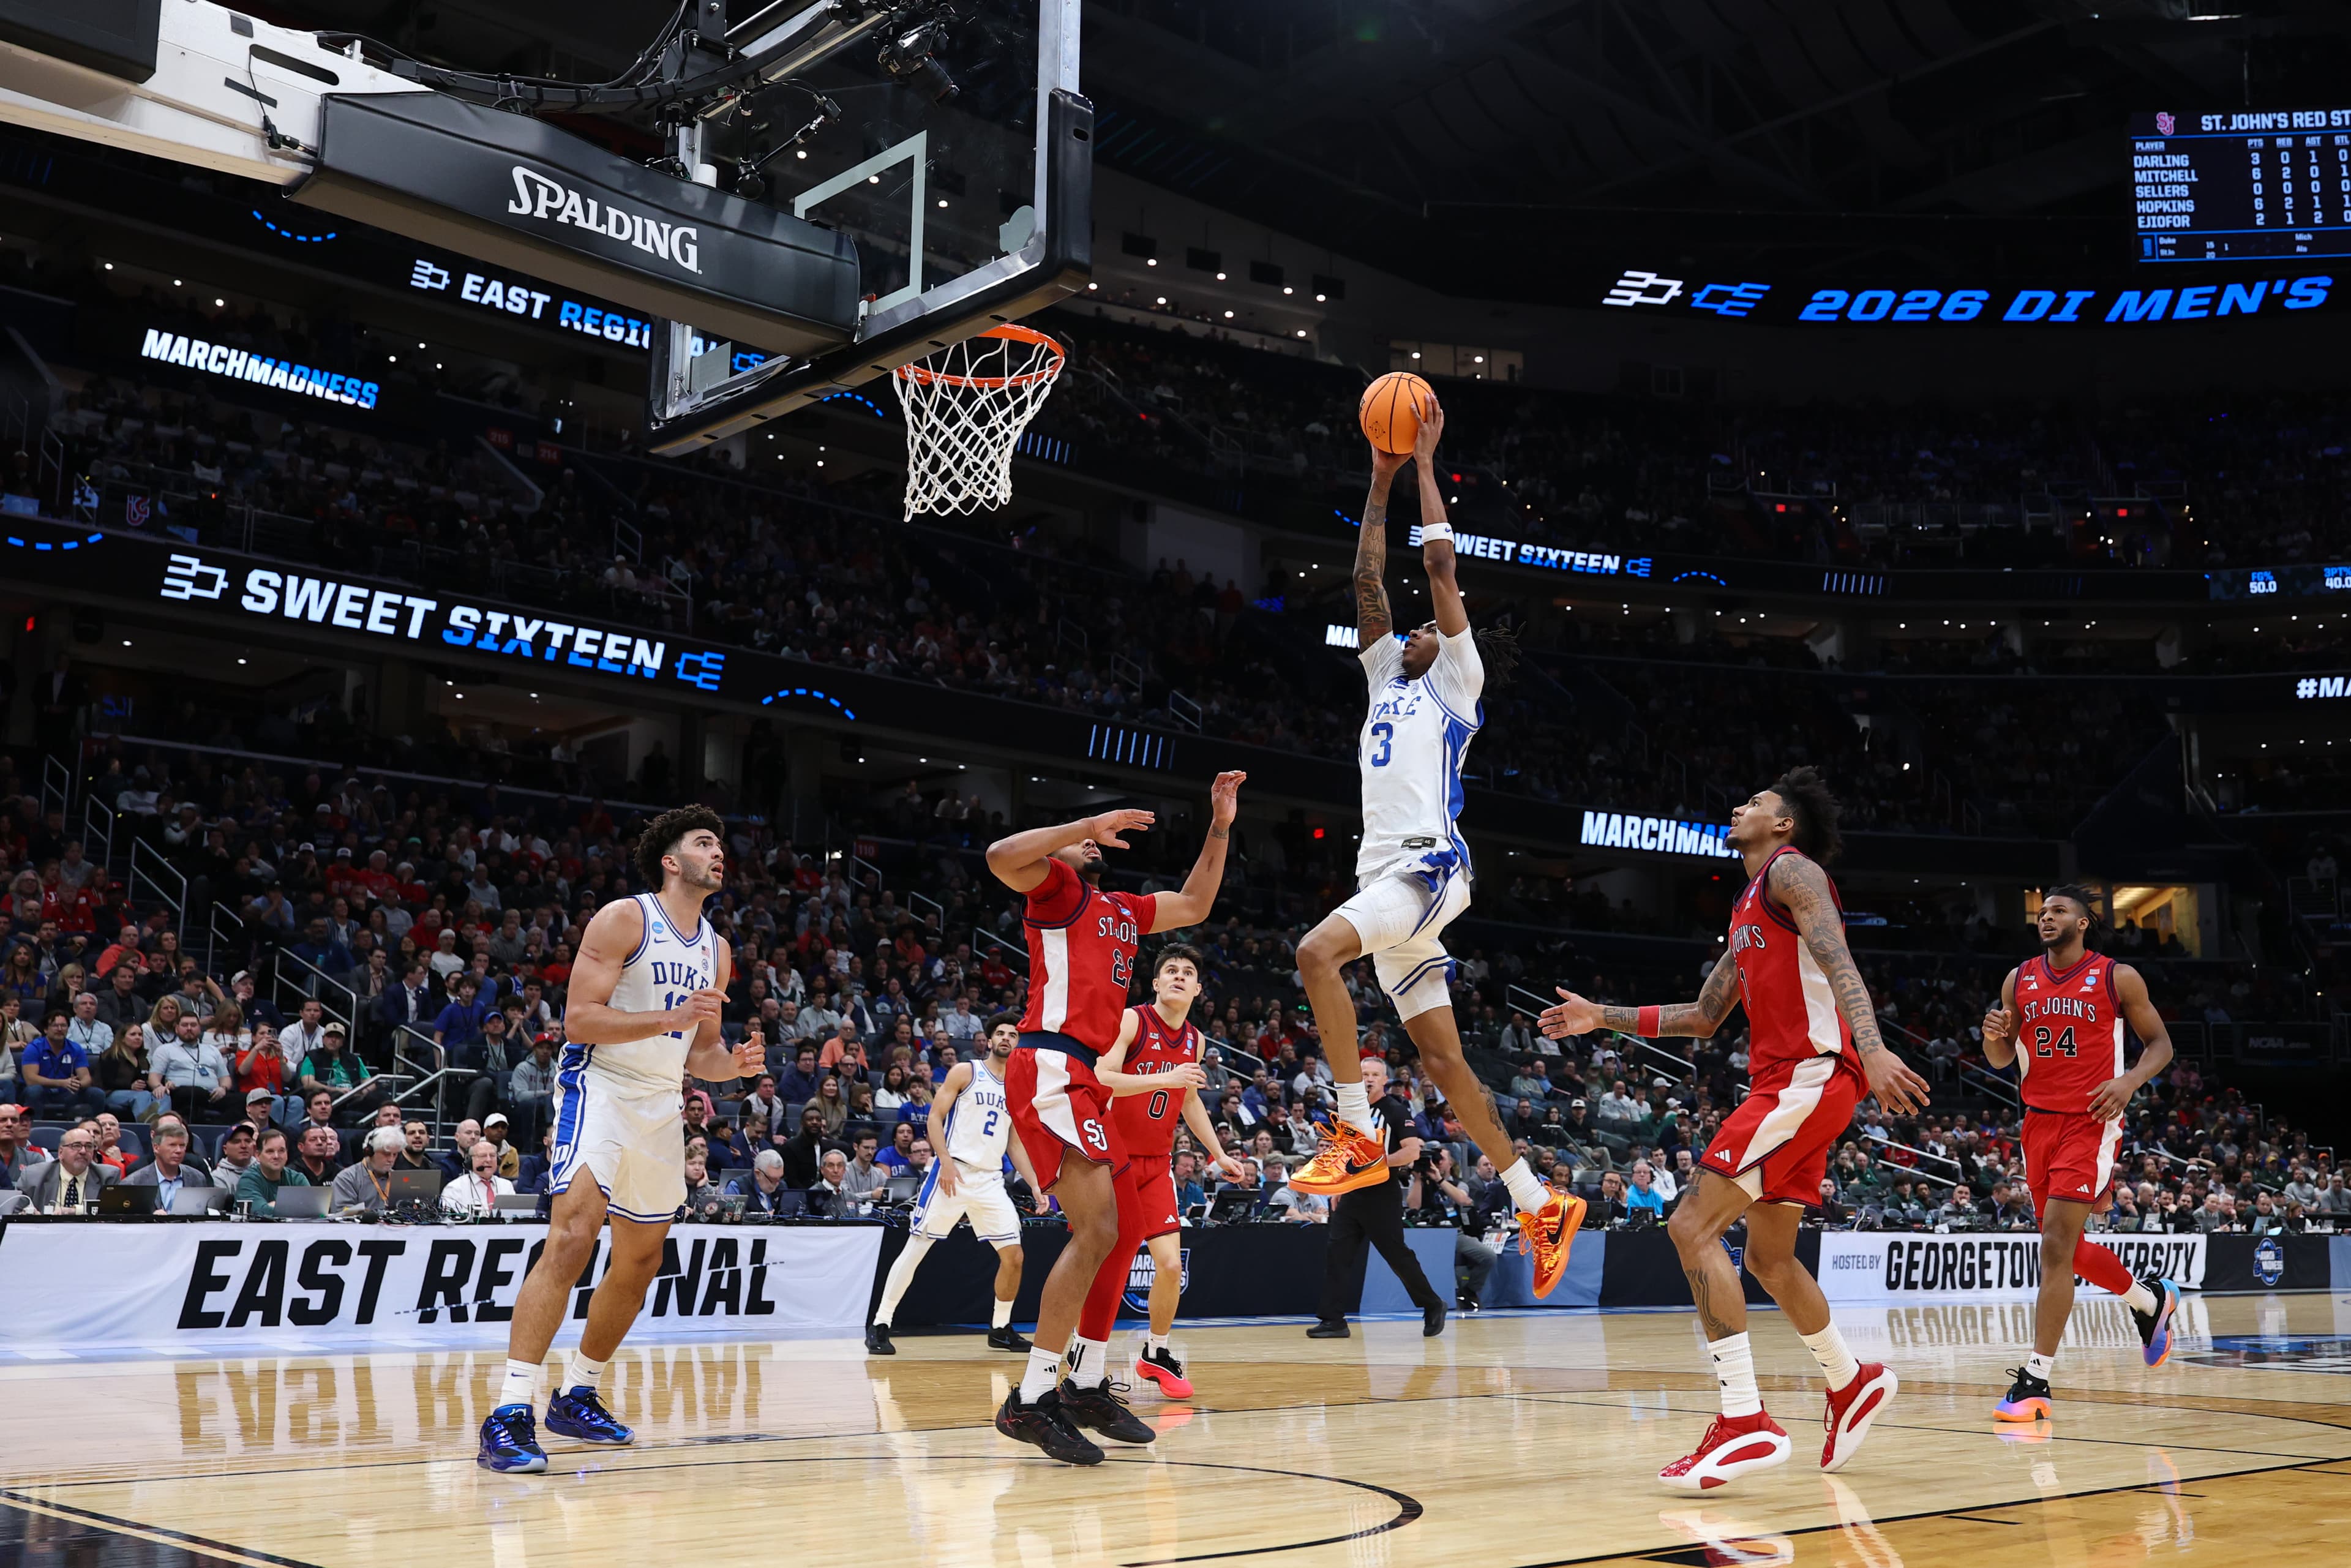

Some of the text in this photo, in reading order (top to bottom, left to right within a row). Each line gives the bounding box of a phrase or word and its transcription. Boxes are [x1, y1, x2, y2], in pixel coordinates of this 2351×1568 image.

[2201, 114, 2226, 131] ST.
[2229, 112, 2289, 130] JOHN'S
[2292, 111, 2327, 129] RED
[2135, 141, 2165, 151] PLAYER
[2248, 138, 2263, 148] PTS
[2305, 136, 2321, 146] AST
[2134, 155, 2189, 168] DARLING
[2251, 152, 2260, 165] 3
[2281, 151, 2290, 164] 0
[2309, 151, 2317, 163] 1
[2339, 149, 2348, 162] 0
[2134, 170, 2199, 183] MITCHELL
[2252, 167, 2261, 180] 6
[2282, 167, 2291, 179] 2
[2310, 165, 2319, 178] 0
[2341, 164, 2349, 177] 1
[2135, 185, 2189, 198] SELLERS
[2253, 182, 2262, 195] 0
[2283, 181, 2292, 194] 0
[2311, 181, 2320, 193] 0
[2341, 179, 2350, 192] 0
[2137, 200, 2195, 213] HOPKINS
[2254, 198, 2263, 210] 6
[2284, 197, 2293, 209] 2
[2313, 195, 2321, 208] 1
[2343, 195, 2351, 207] 1
[508, 165, 698, 274] SPALDING
[2137, 215, 2191, 228] EJIOFOR
[2255, 213, 2265, 225] 2
[2286, 212, 2294, 225] 1
[2314, 211, 2323, 223] 2
[2344, 209, 2351, 222] 0
[461, 273, 550, 319] EAST
[1798, 276, 2333, 322] 2026 DI MEN'S
[141, 329, 379, 410] MARCHMADNESS
[1454, 532, 1621, 574] WEET SIXTEEN
[2251, 571, 2273, 581] FG%
[2324, 566, 2351, 577] 3PT%
[2249, 580, 2277, 594] 50.0
[2325, 577, 2351, 589] 40.0
[241, 569, 666, 680] SWEET SIXTEEN
[1371, 721, 1393, 767] 3
[1098, 917, 1115, 937] ST.
[2024, 997, 2096, 1022] ST. JOHN'S
[2034, 1026, 2077, 1057] 24
[1147, 1089, 1169, 1120] 0
[983, 1110, 999, 1137] 2
[1832, 1255, 1881, 1270] HOSTED BY
[1886, 1240, 2041, 1290] GEORGETOW
[177, 1239, 405, 1329] EAST
